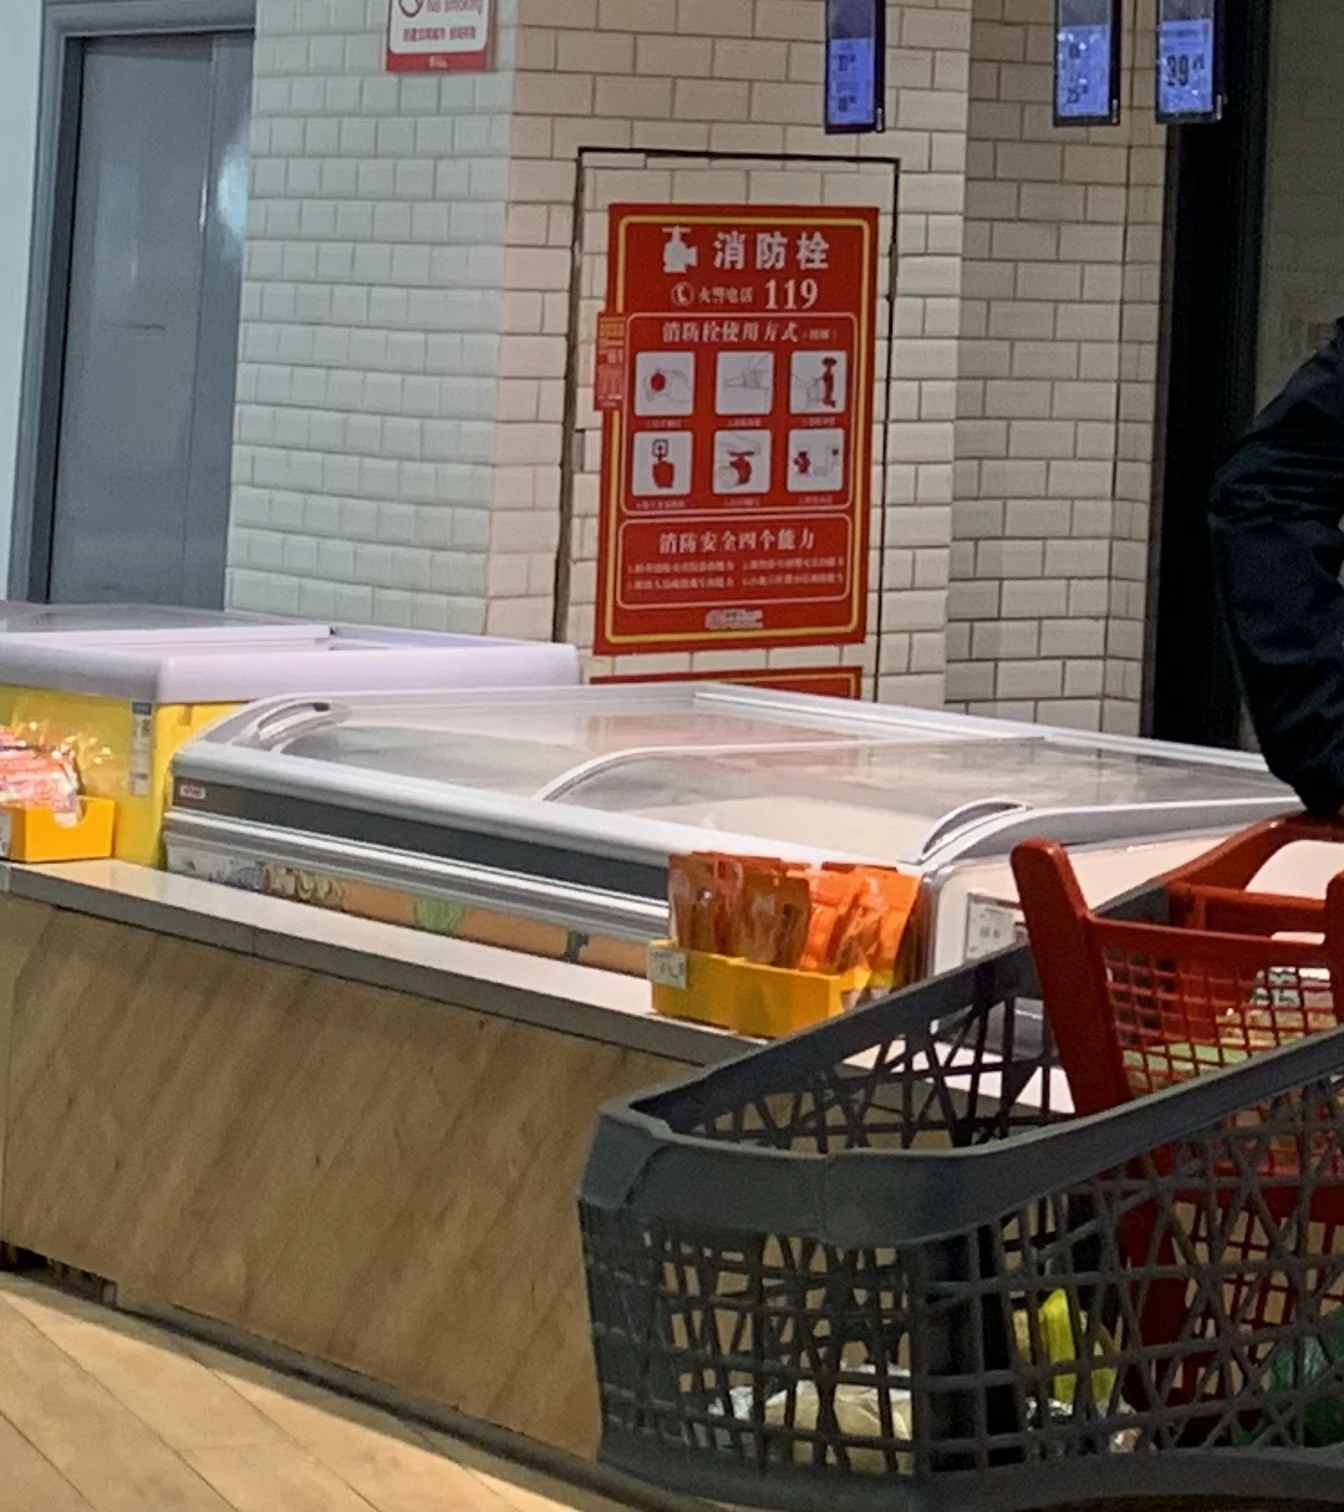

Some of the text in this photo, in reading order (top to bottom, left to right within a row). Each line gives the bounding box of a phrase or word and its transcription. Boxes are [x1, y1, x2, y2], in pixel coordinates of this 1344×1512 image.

[713, 230, 830, 270] 消防栓
[764, 278, 819, 310] 119
